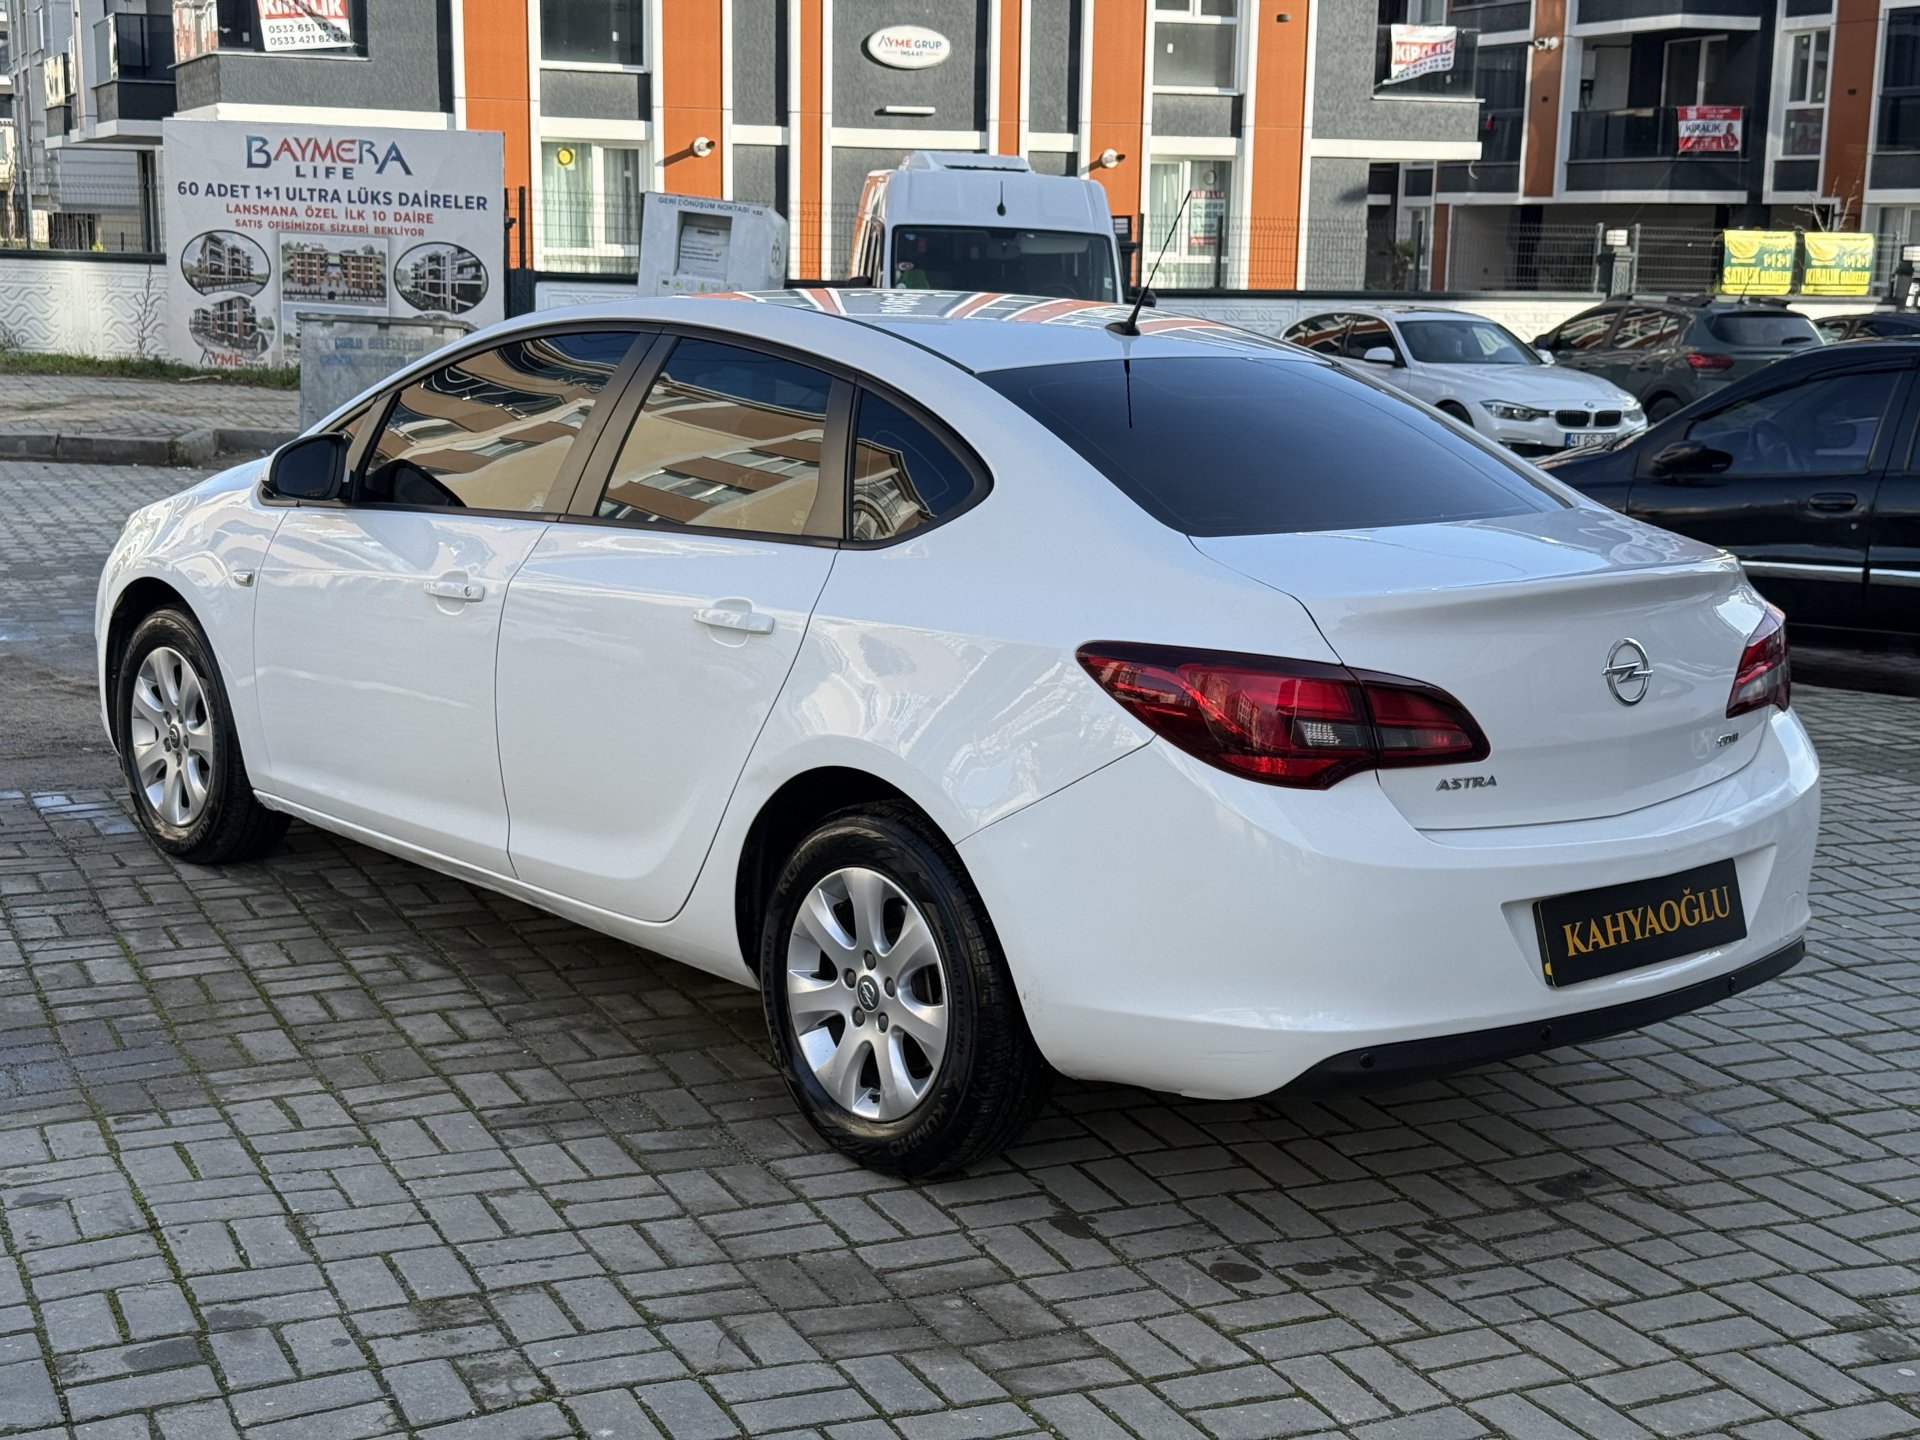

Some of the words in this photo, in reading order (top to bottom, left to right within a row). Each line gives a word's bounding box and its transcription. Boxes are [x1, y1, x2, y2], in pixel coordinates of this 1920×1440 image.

[268, 25, 295, 33] 0532
[298, 23, 315, 32] 651
[270, 37, 296, 45] 0533
[298, 35, 316, 44] 421
[318, 34, 331, 43] 82
[333, 34, 347, 42] 56
[914, 40, 942, 49] GRUP
[246, 134, 414, 176] BAYMERA
[295, 165, 355, 180] LIFE
[177, 181, 199, 196] 60
[204, 183, 250, 199] ADET
[255, 185, 281, 200] 1+1
[285, 187, 342, 204] ULTRA
[347, 187, 393, 205] LÜKS
[398, 190, 488, 211] DAİRELER
[658, 196, 677, 206] GERİ
[717, 203, 750, 214] NOKTASI
[225, 203, 299, 218] LANSMANA
[304, 205, 339, 219] ÖZEL
[344, 207, 366, 220] İLK
[372, 210, 387, 222] 10
[393, 210, 434, 224] DAİRE
[235, 218, 264, 229] SATIŞ
[330, 223, 369, 235] SİZLERİ
[374, 226, 425, 237] BEKLİYOR
[199, 347, 244, 367] AYME
[1435, 774, 1498, 792] ASTRA
[1562, 885, 1732, 957] KAHYAOĞLU
